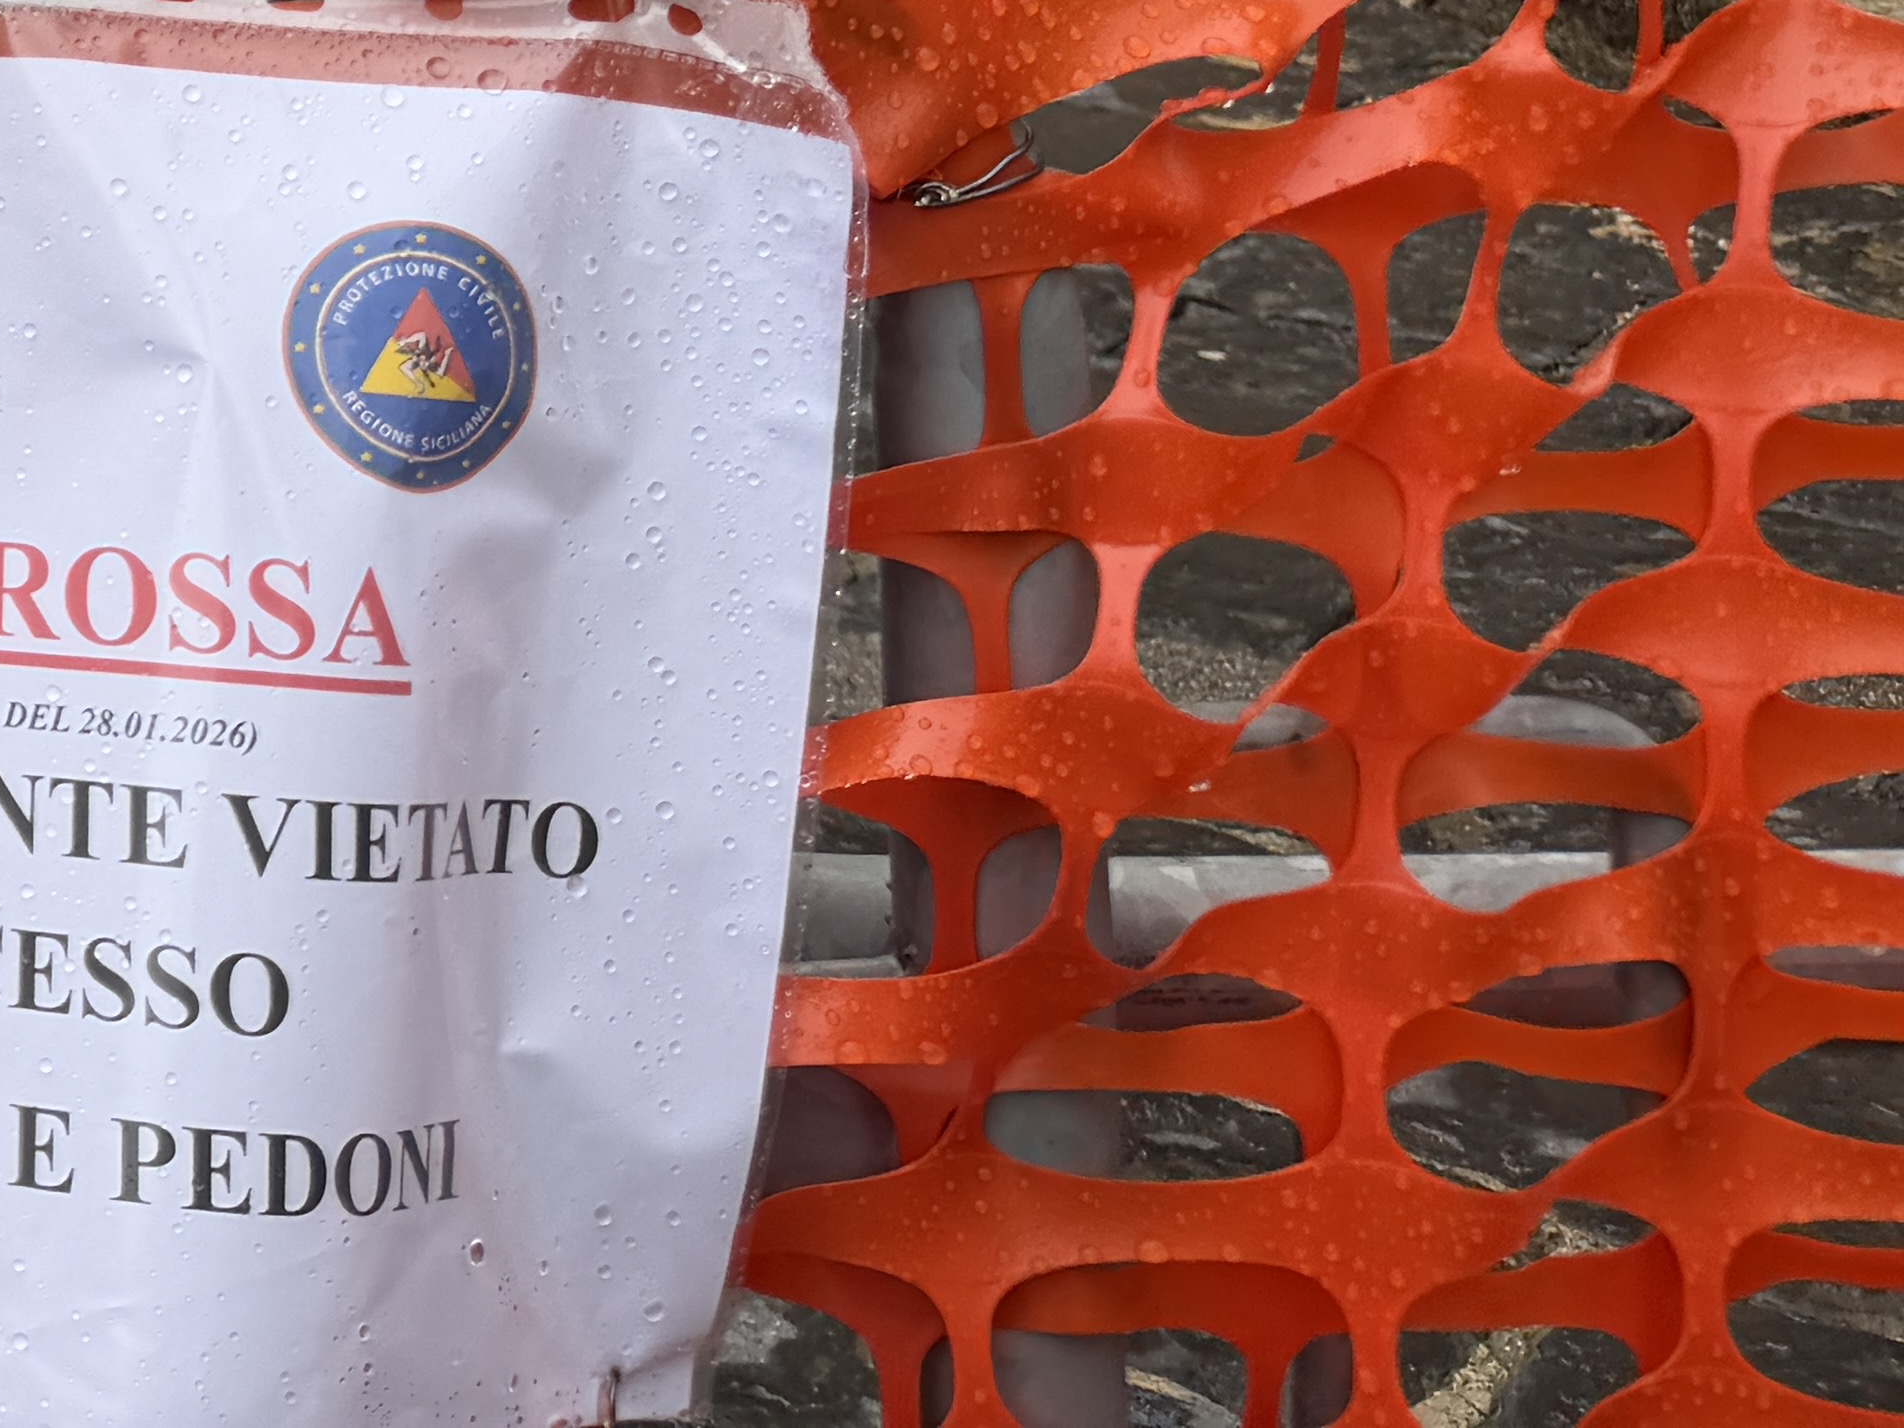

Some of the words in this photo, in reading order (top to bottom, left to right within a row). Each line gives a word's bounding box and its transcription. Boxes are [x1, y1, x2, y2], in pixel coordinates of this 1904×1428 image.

[333, 260, 449, 326] PROTEZIONE
[457, 277, 505, 340] CIVILE
[342, 390, 415, 448] REGIONE
[421, 403, 494, 451] SICILIANA
[3, 702, 71, 735] DEL
[77, 706, 259, 756] 28.01.2026)
[221, 792, 600, 882] VIETATO
[8, 1103, 74, 1195] E
[109, 1118, 460, 1218] PEDONI
